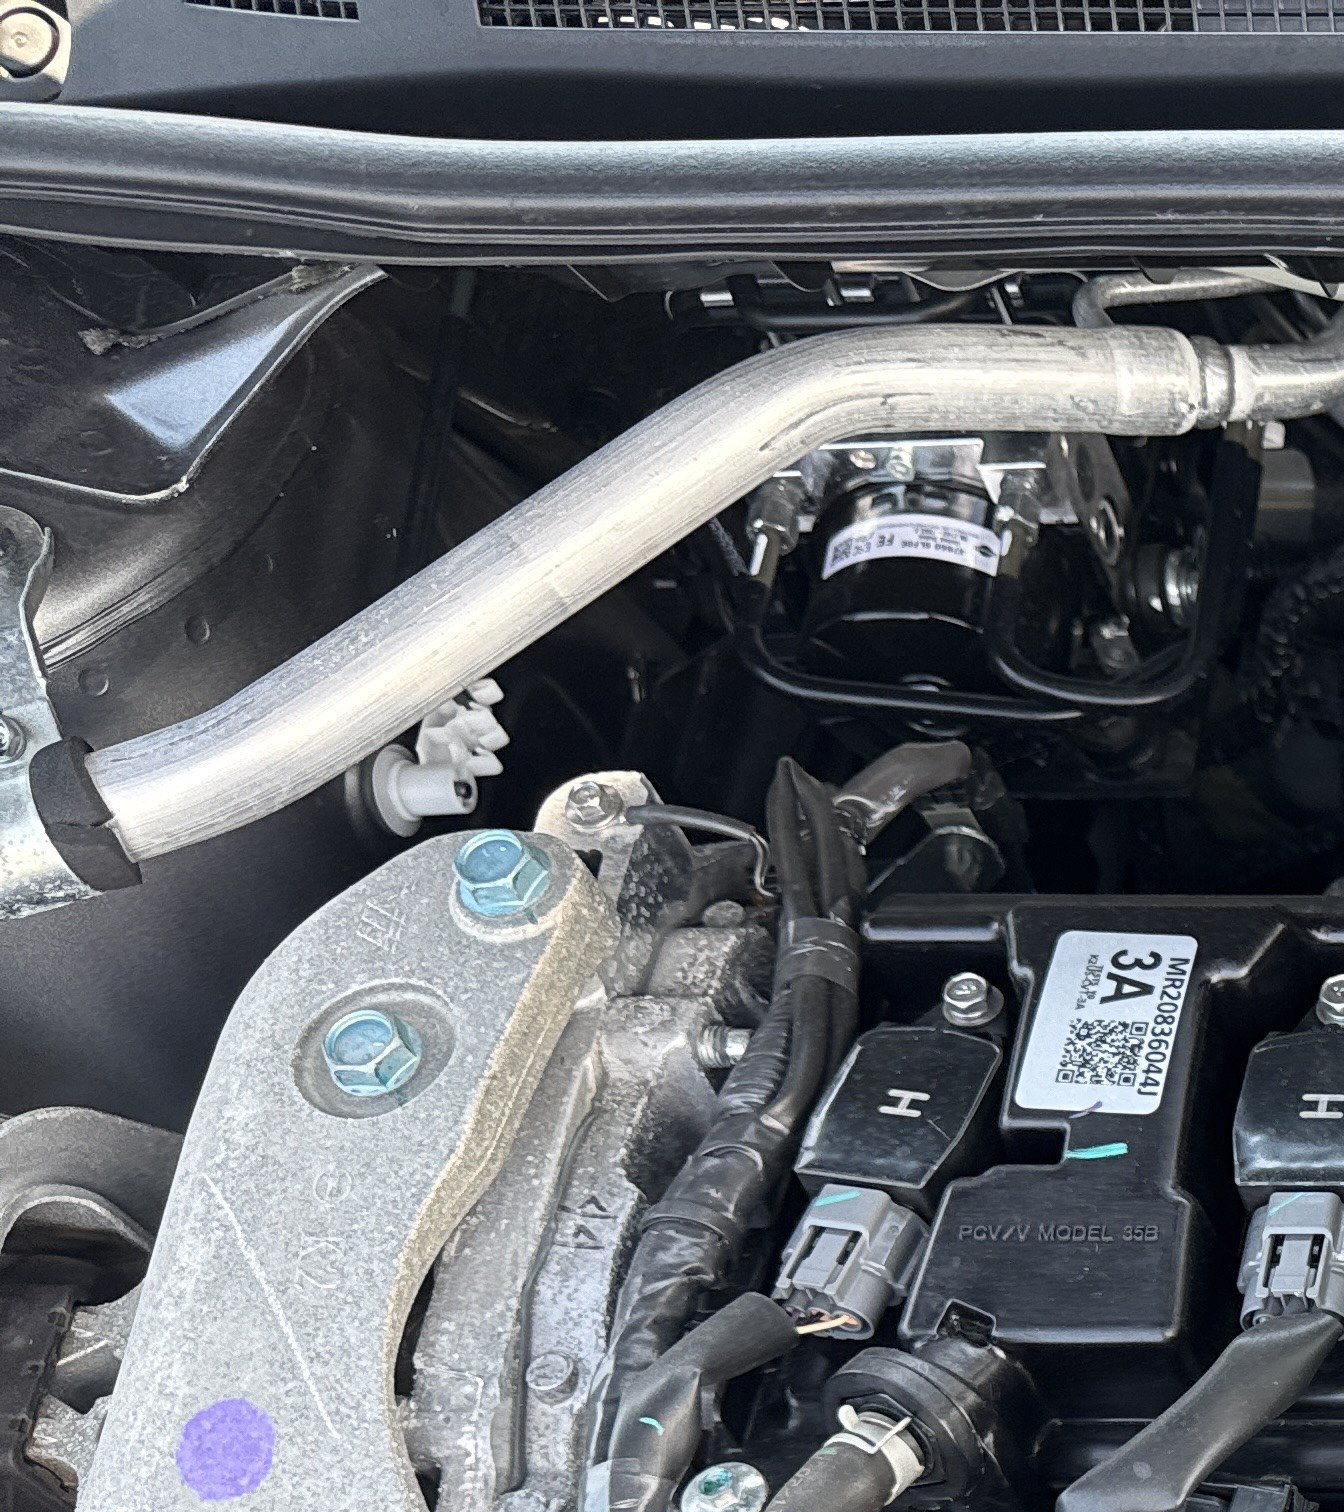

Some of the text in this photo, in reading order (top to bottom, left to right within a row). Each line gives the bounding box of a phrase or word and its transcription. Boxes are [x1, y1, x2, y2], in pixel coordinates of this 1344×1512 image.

[1099, 949, 1163, 1005] 3A
[1137, 957, 1191, 1097] MR20836044J
[878, 1088, 930, 1117] H
[1037, 1224, 1115, 1243] MODEL
[1122, 1224, 1160, 1242] 35B
